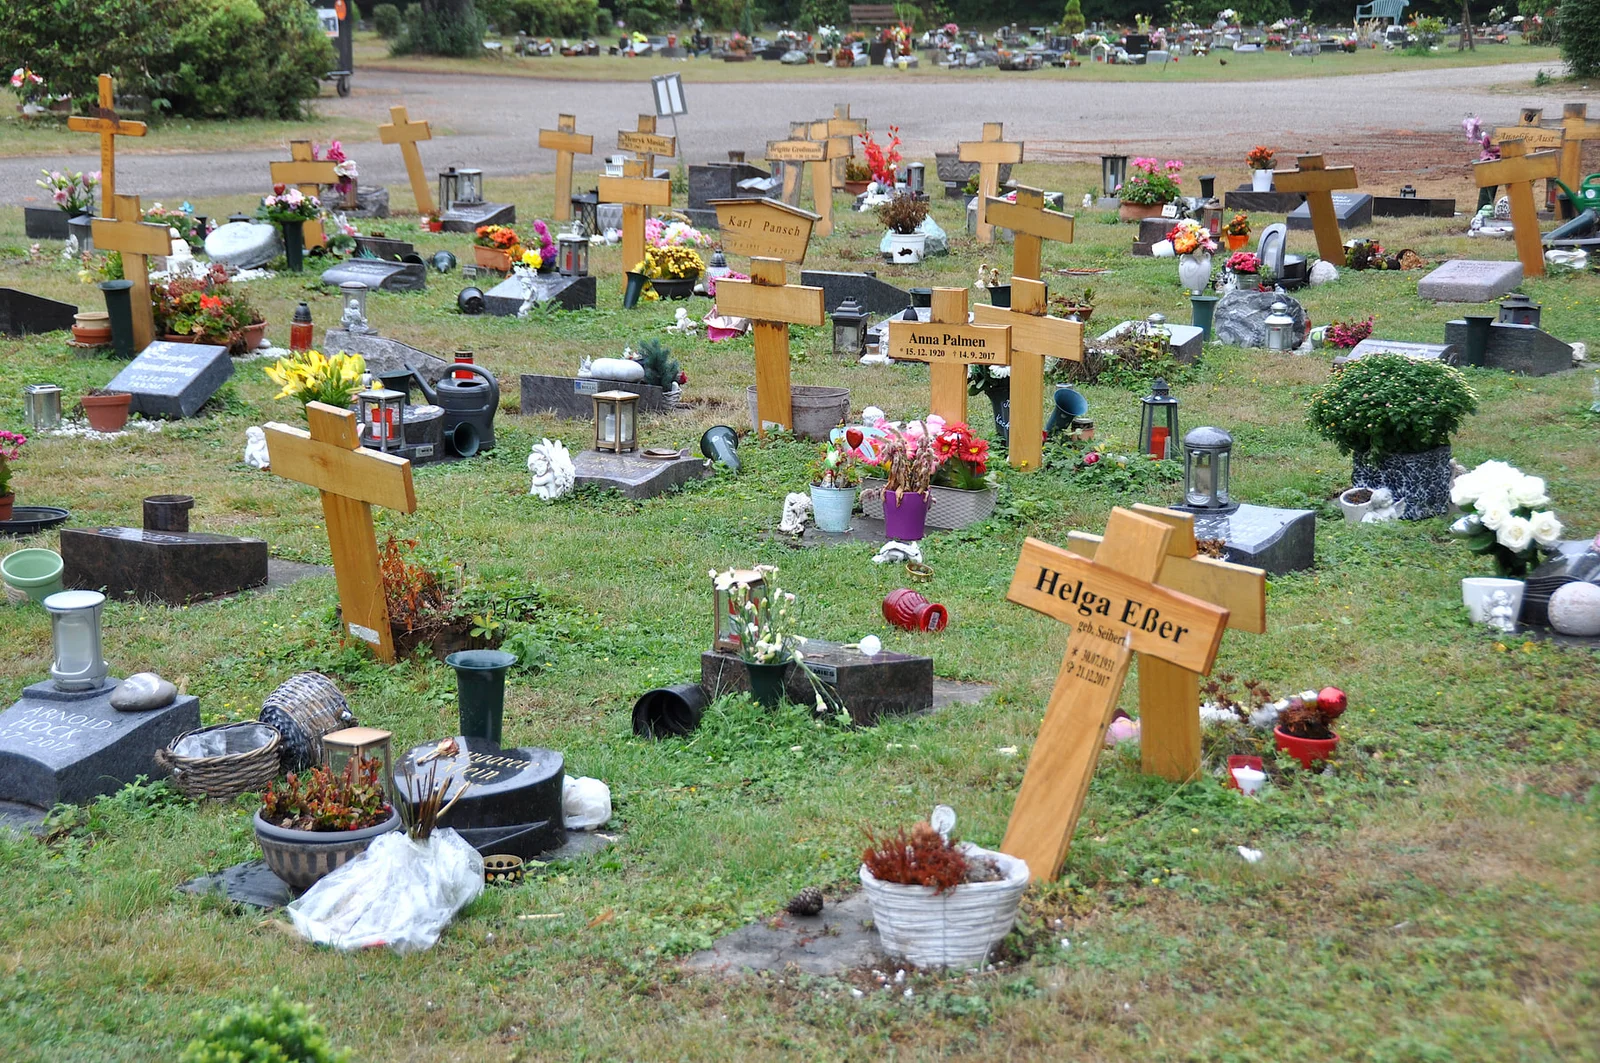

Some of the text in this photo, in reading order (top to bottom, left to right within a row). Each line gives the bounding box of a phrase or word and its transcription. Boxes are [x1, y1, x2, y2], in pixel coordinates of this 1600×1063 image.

[1535, 134, 1555, 142] Aust
[728, 215, 800, 236] Karl Pansch
[909, 333, 986, 347] Anna Palmen
[1033, 565, 1189, 644] Helga Eßer
[1076, 619, 1126, 647] geb. Seibert
[1080, 649, 1115, 673] 30.07.1931
[1075, 664, 1110, 687] 21.12.2017
[8, 716, 83, 740] HOCK
[23, 706, 113, 730] ARNOLD
